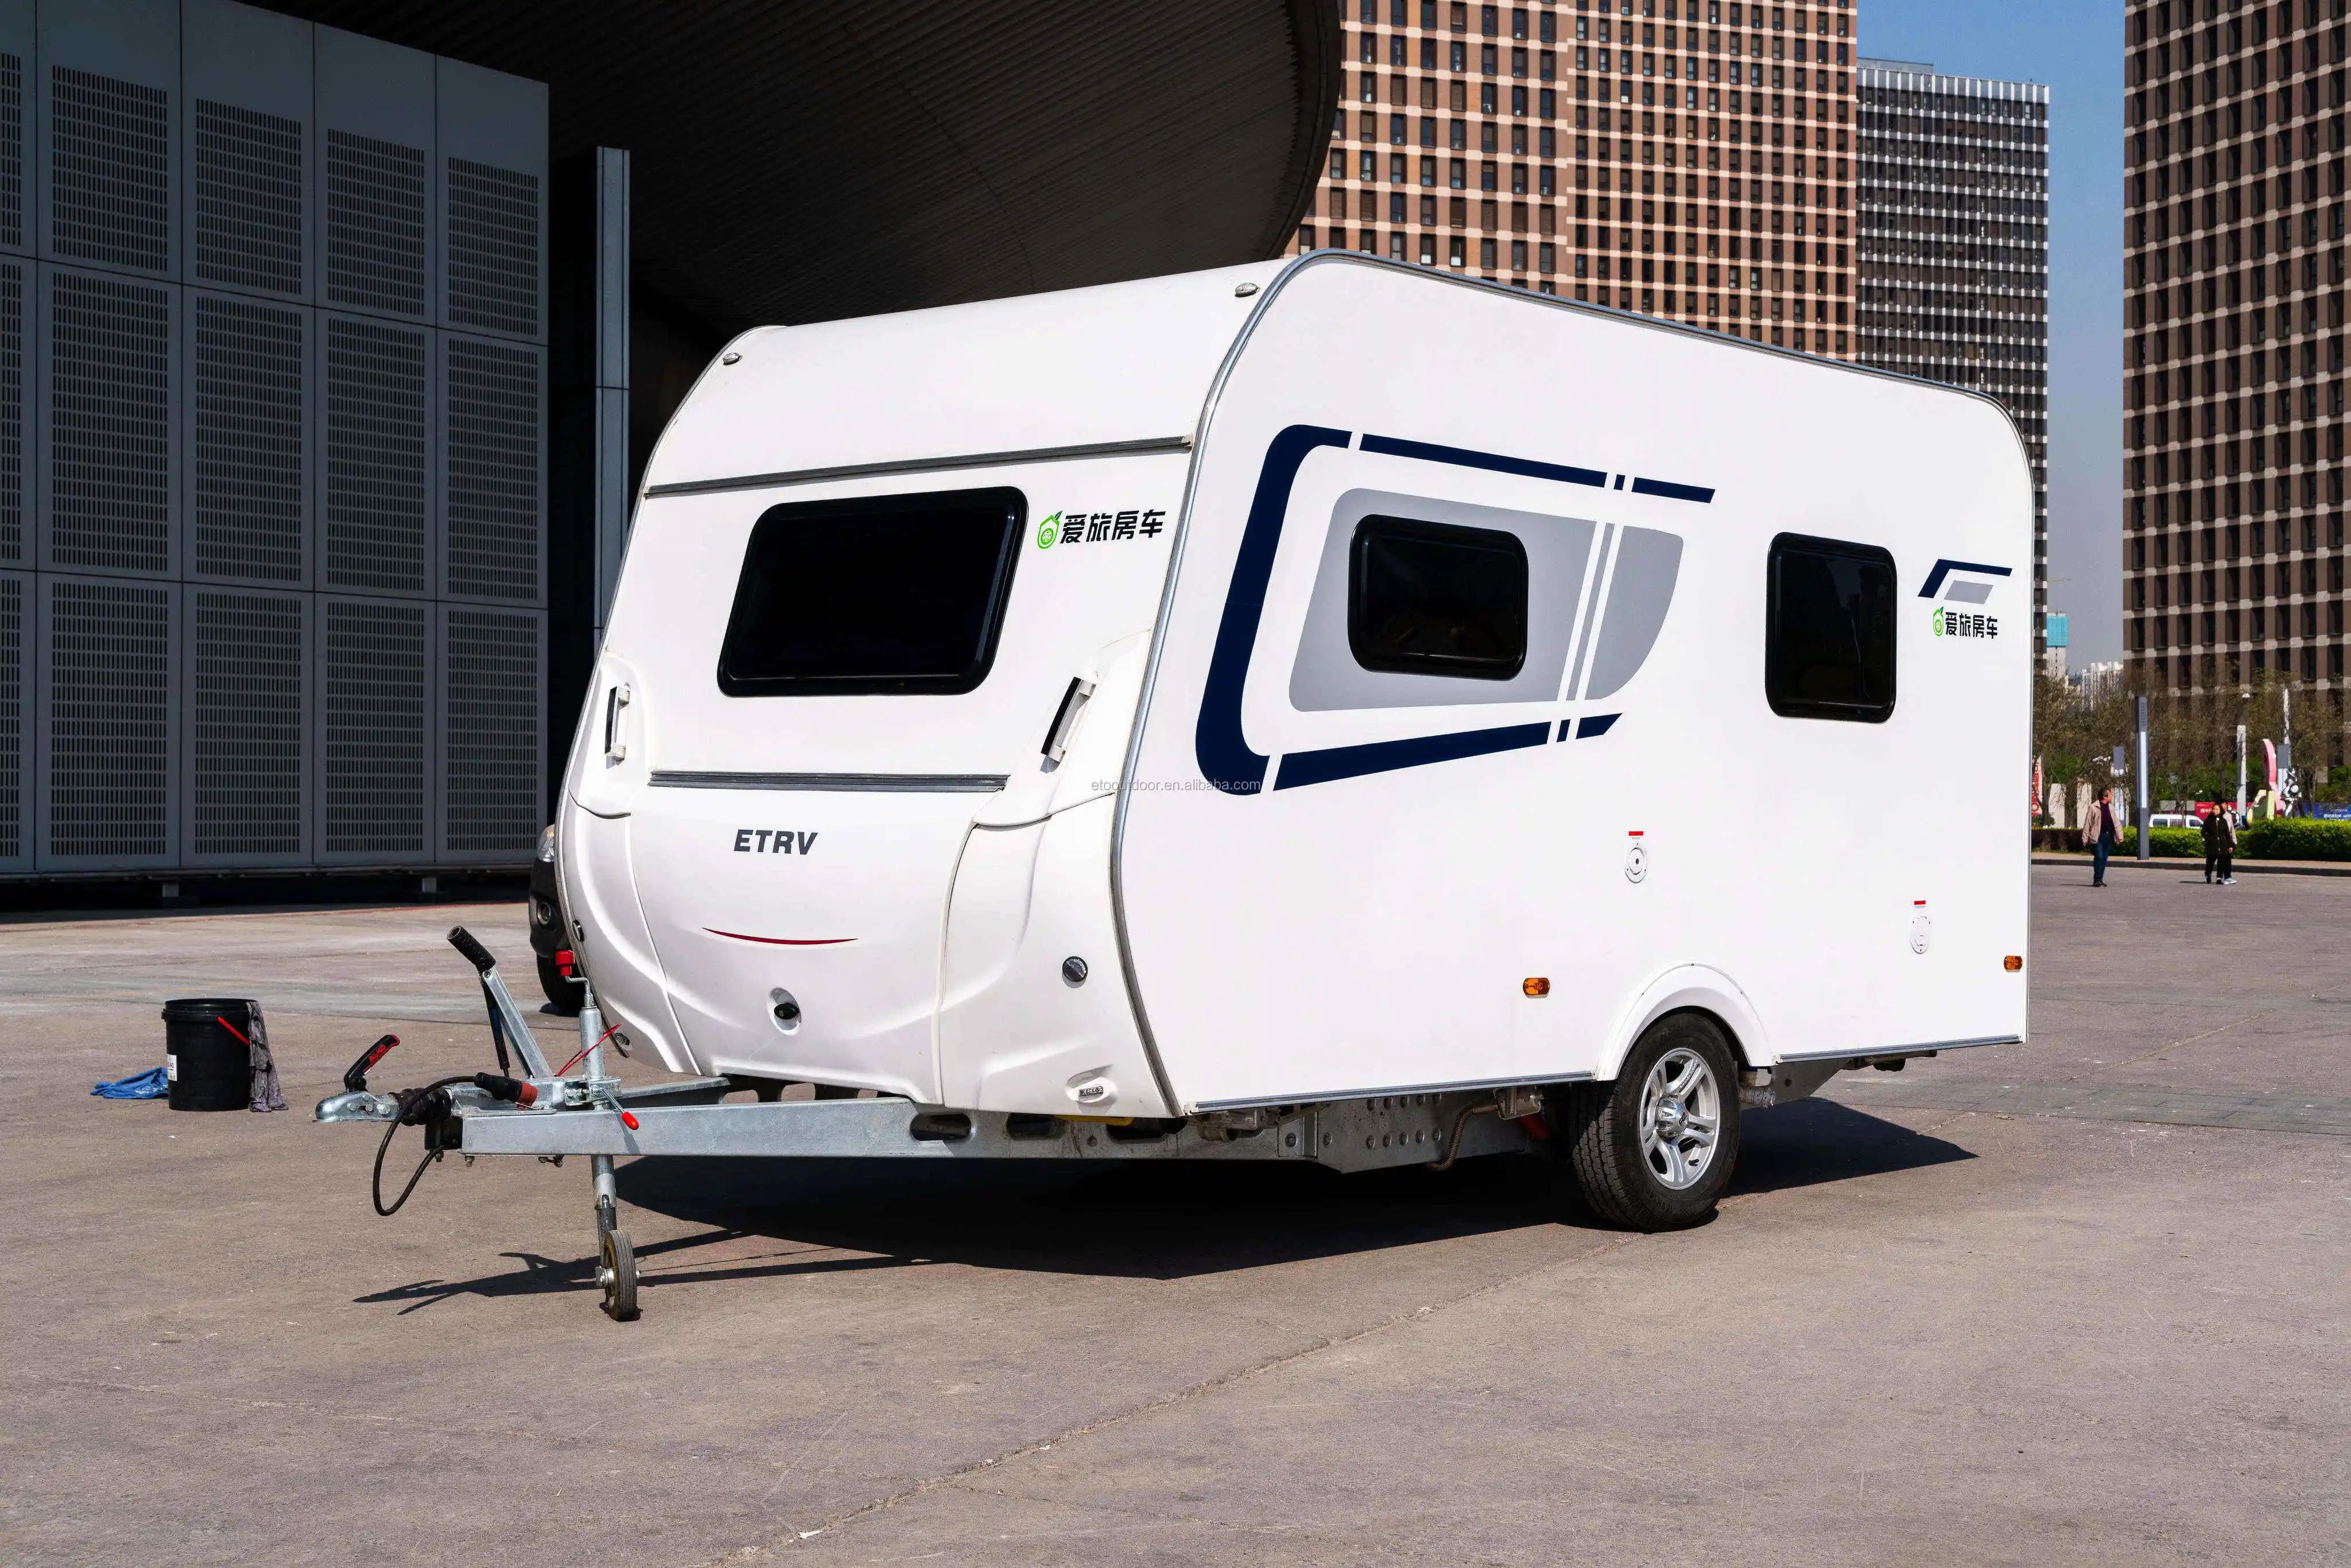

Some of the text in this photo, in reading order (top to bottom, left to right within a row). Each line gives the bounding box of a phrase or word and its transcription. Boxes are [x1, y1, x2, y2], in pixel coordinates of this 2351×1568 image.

[1060, 509, 1166, 544] 爱旅房车
[1945, 612, 1998, 639] 爱旅房车
[734, 829, 818, 855] ETRV
